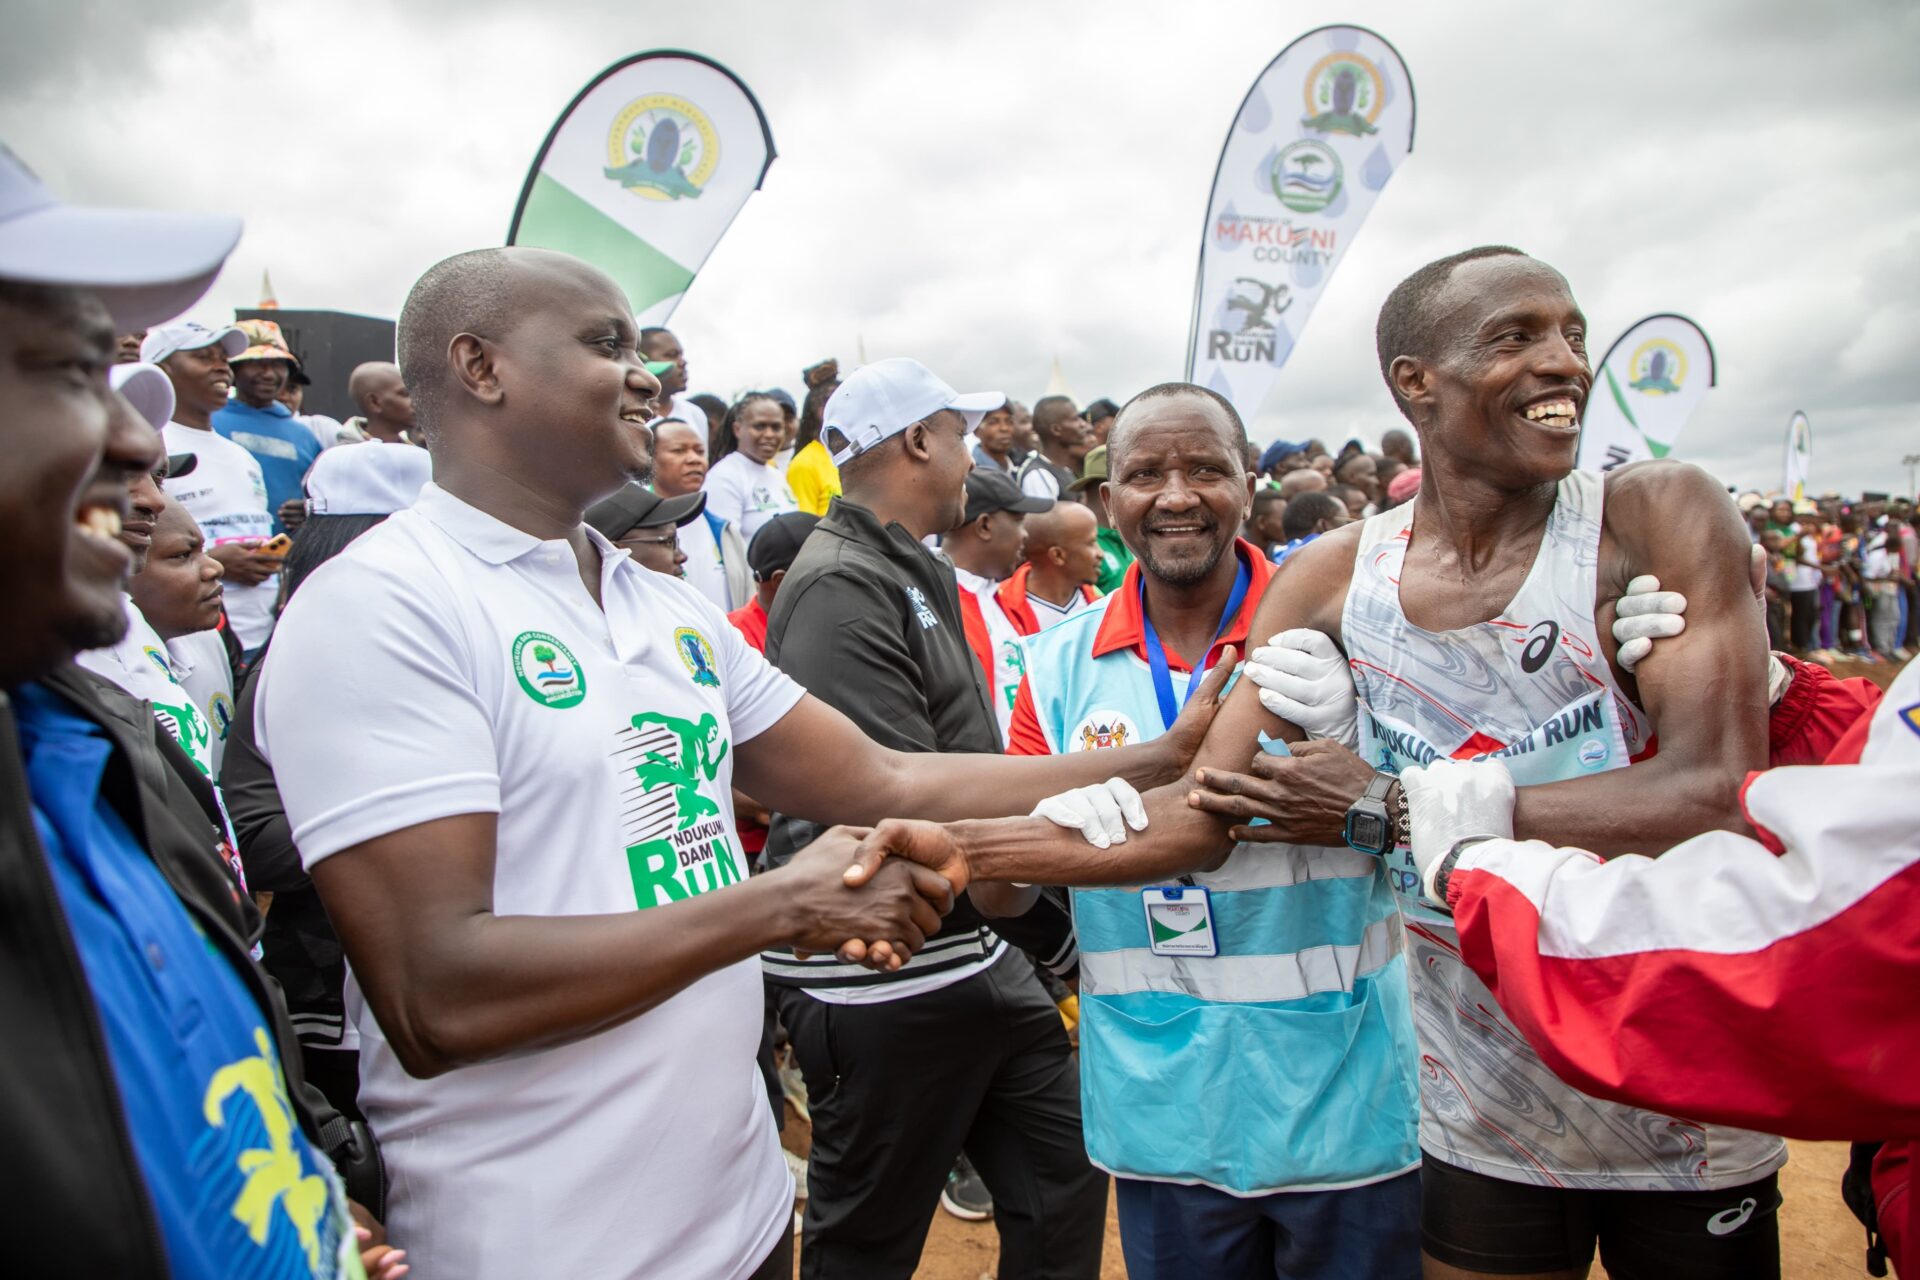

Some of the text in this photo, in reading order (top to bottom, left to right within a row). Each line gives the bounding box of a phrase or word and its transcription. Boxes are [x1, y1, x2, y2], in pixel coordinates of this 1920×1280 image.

[1253, 246, 1333, 266] COUNTY
[1208, 329, 1276, 362] RUN
[1543, 699, 1604, 747] RUN
[678, 842, 713, 867] DAM
[626, 836, 742, 911] RUN
